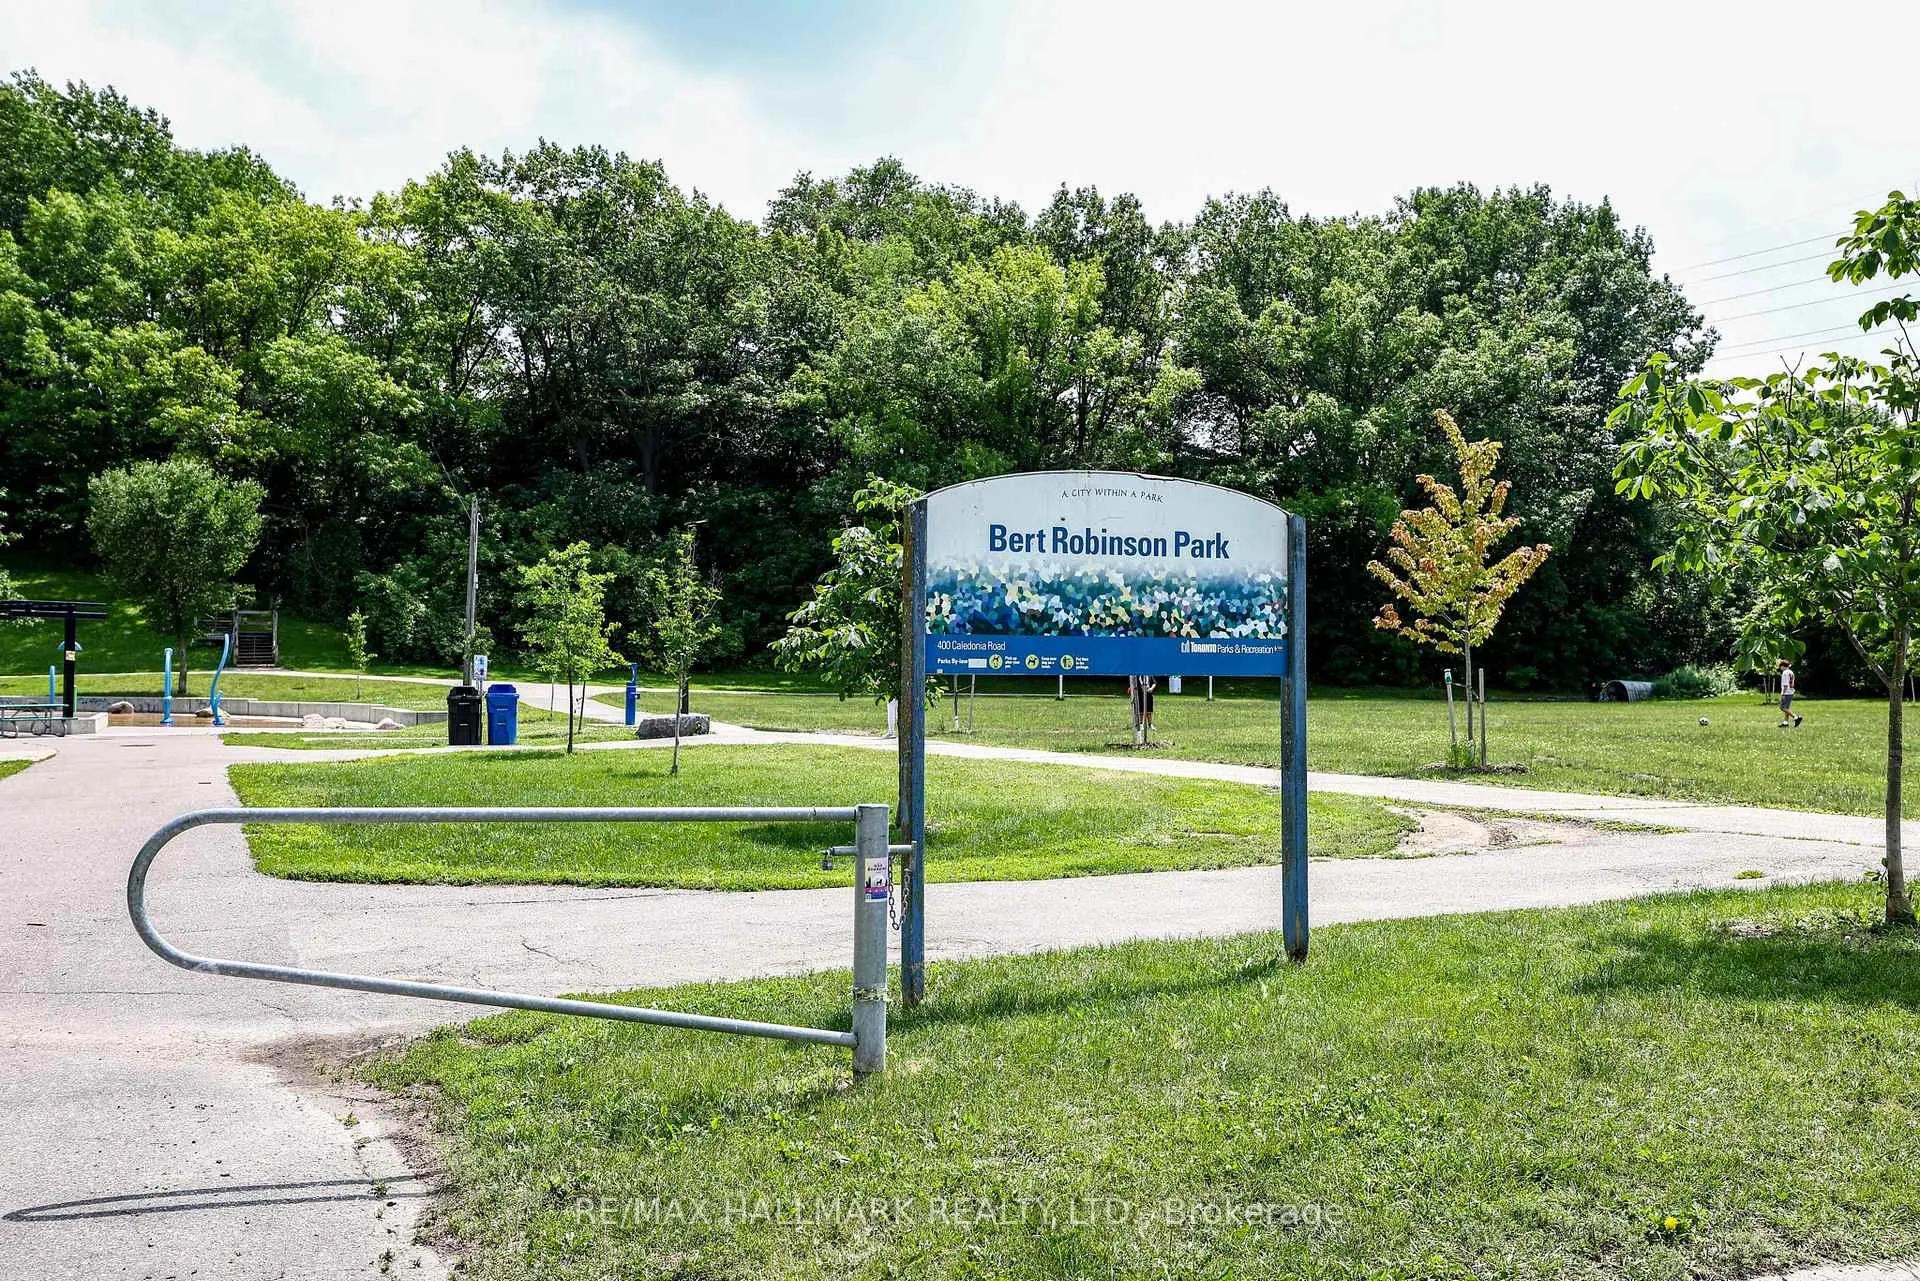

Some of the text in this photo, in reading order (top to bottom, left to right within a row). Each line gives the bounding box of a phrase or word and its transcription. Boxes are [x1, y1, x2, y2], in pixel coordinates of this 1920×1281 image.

[1061, 487, 1164, 503] A CITY WITHIN A PARK
[988, 524, 1230, 559] Bert Robinson Park
[937, 640, 1006, 651] 400 Caledonia Road
[1217, 644, 1234, 654] Parks
[1234, 644, 1241, 654] &
[1241, 644, 1274, 654] Recreation
